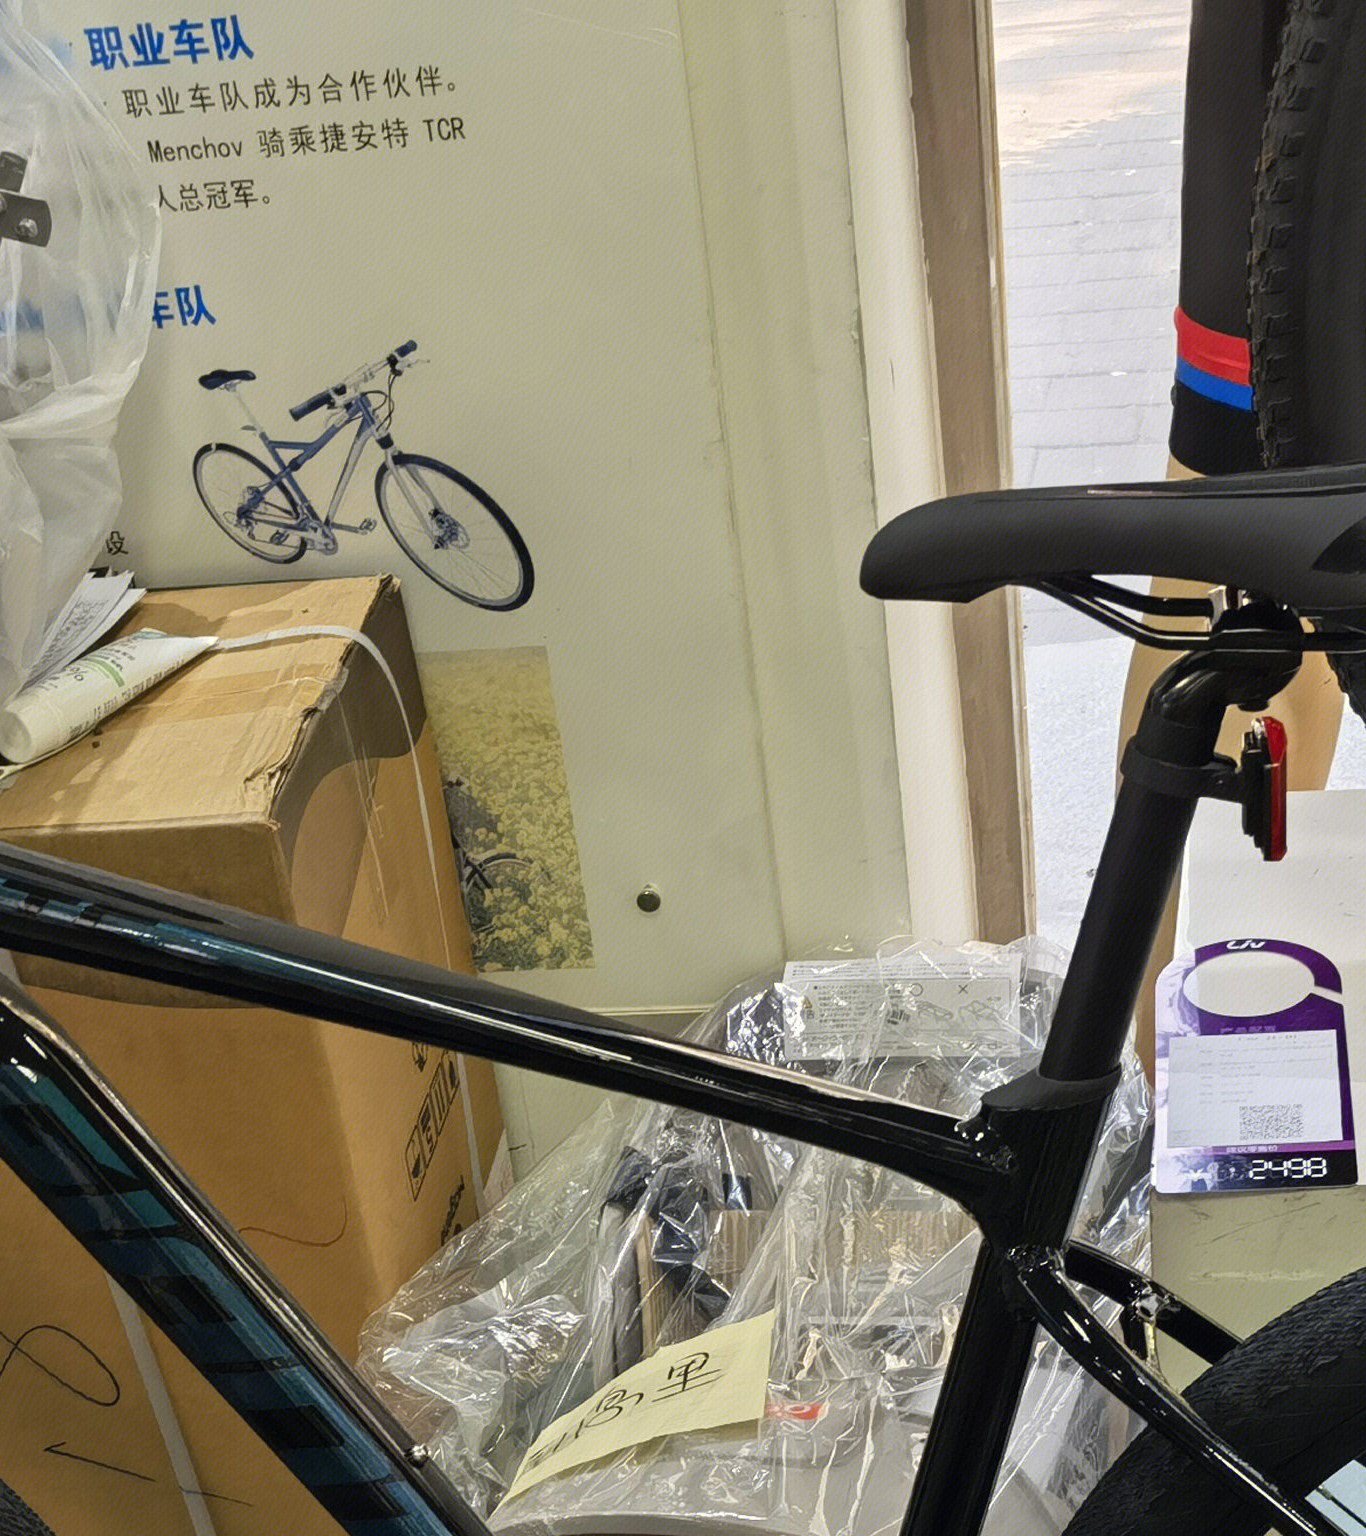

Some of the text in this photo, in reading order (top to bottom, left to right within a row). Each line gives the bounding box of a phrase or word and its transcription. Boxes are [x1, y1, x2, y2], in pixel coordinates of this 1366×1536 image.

[84, 14, 254, 70] 职业车队
[122, 64, 458, 119] 职业车队成为合作伙伴。
[147, 117, 466, 164] Menchov 骑乘捷安特 TCR
[1226, 938, 1266, 950] Liv
[1248, 1156, 1328, 1181] 2498
